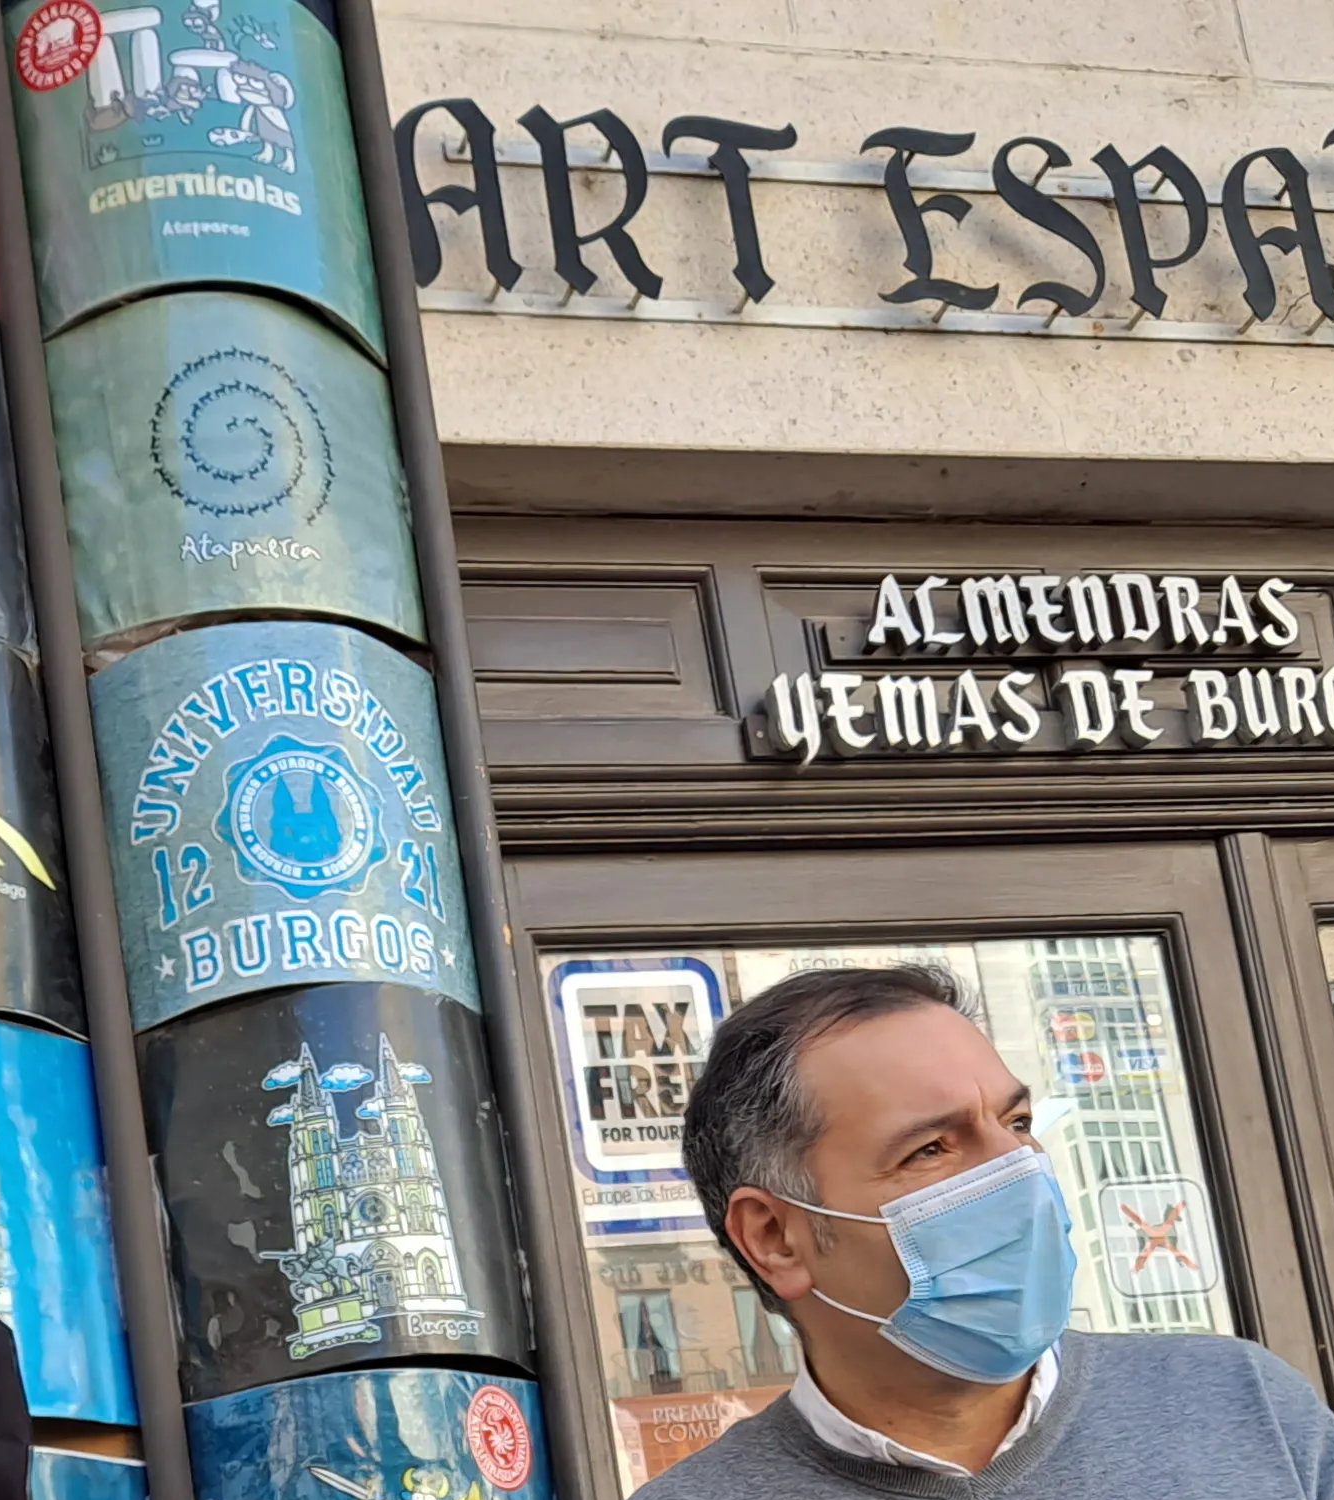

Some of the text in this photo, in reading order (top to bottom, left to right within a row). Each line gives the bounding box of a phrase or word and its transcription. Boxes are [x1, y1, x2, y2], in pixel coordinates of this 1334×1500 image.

[393, 98, 797, 301] ART
[181, 532, 322, 565] Atapuerca
[868, 573, 1300, 650] ALMENDRAS
[771, 668, 1041, 771] YEMAS
[1060, 669, 1165, 743] DE
[131, 658, 443, 845] UNIVERSIDAD
[152, 839, 445, 931] 12 21
[180, 910, 438, 993] BURGOS
[583, 1002, 694, 1059] TAX
[584, 1062, 706, 1122] FRE
[1128, 1057, 1160, 1070] VISA
[601, 1127, 633, 1144] FOR
[581, 1188, 631, 1206] Europe
[407, 1310, 481, 1342] Burgos
